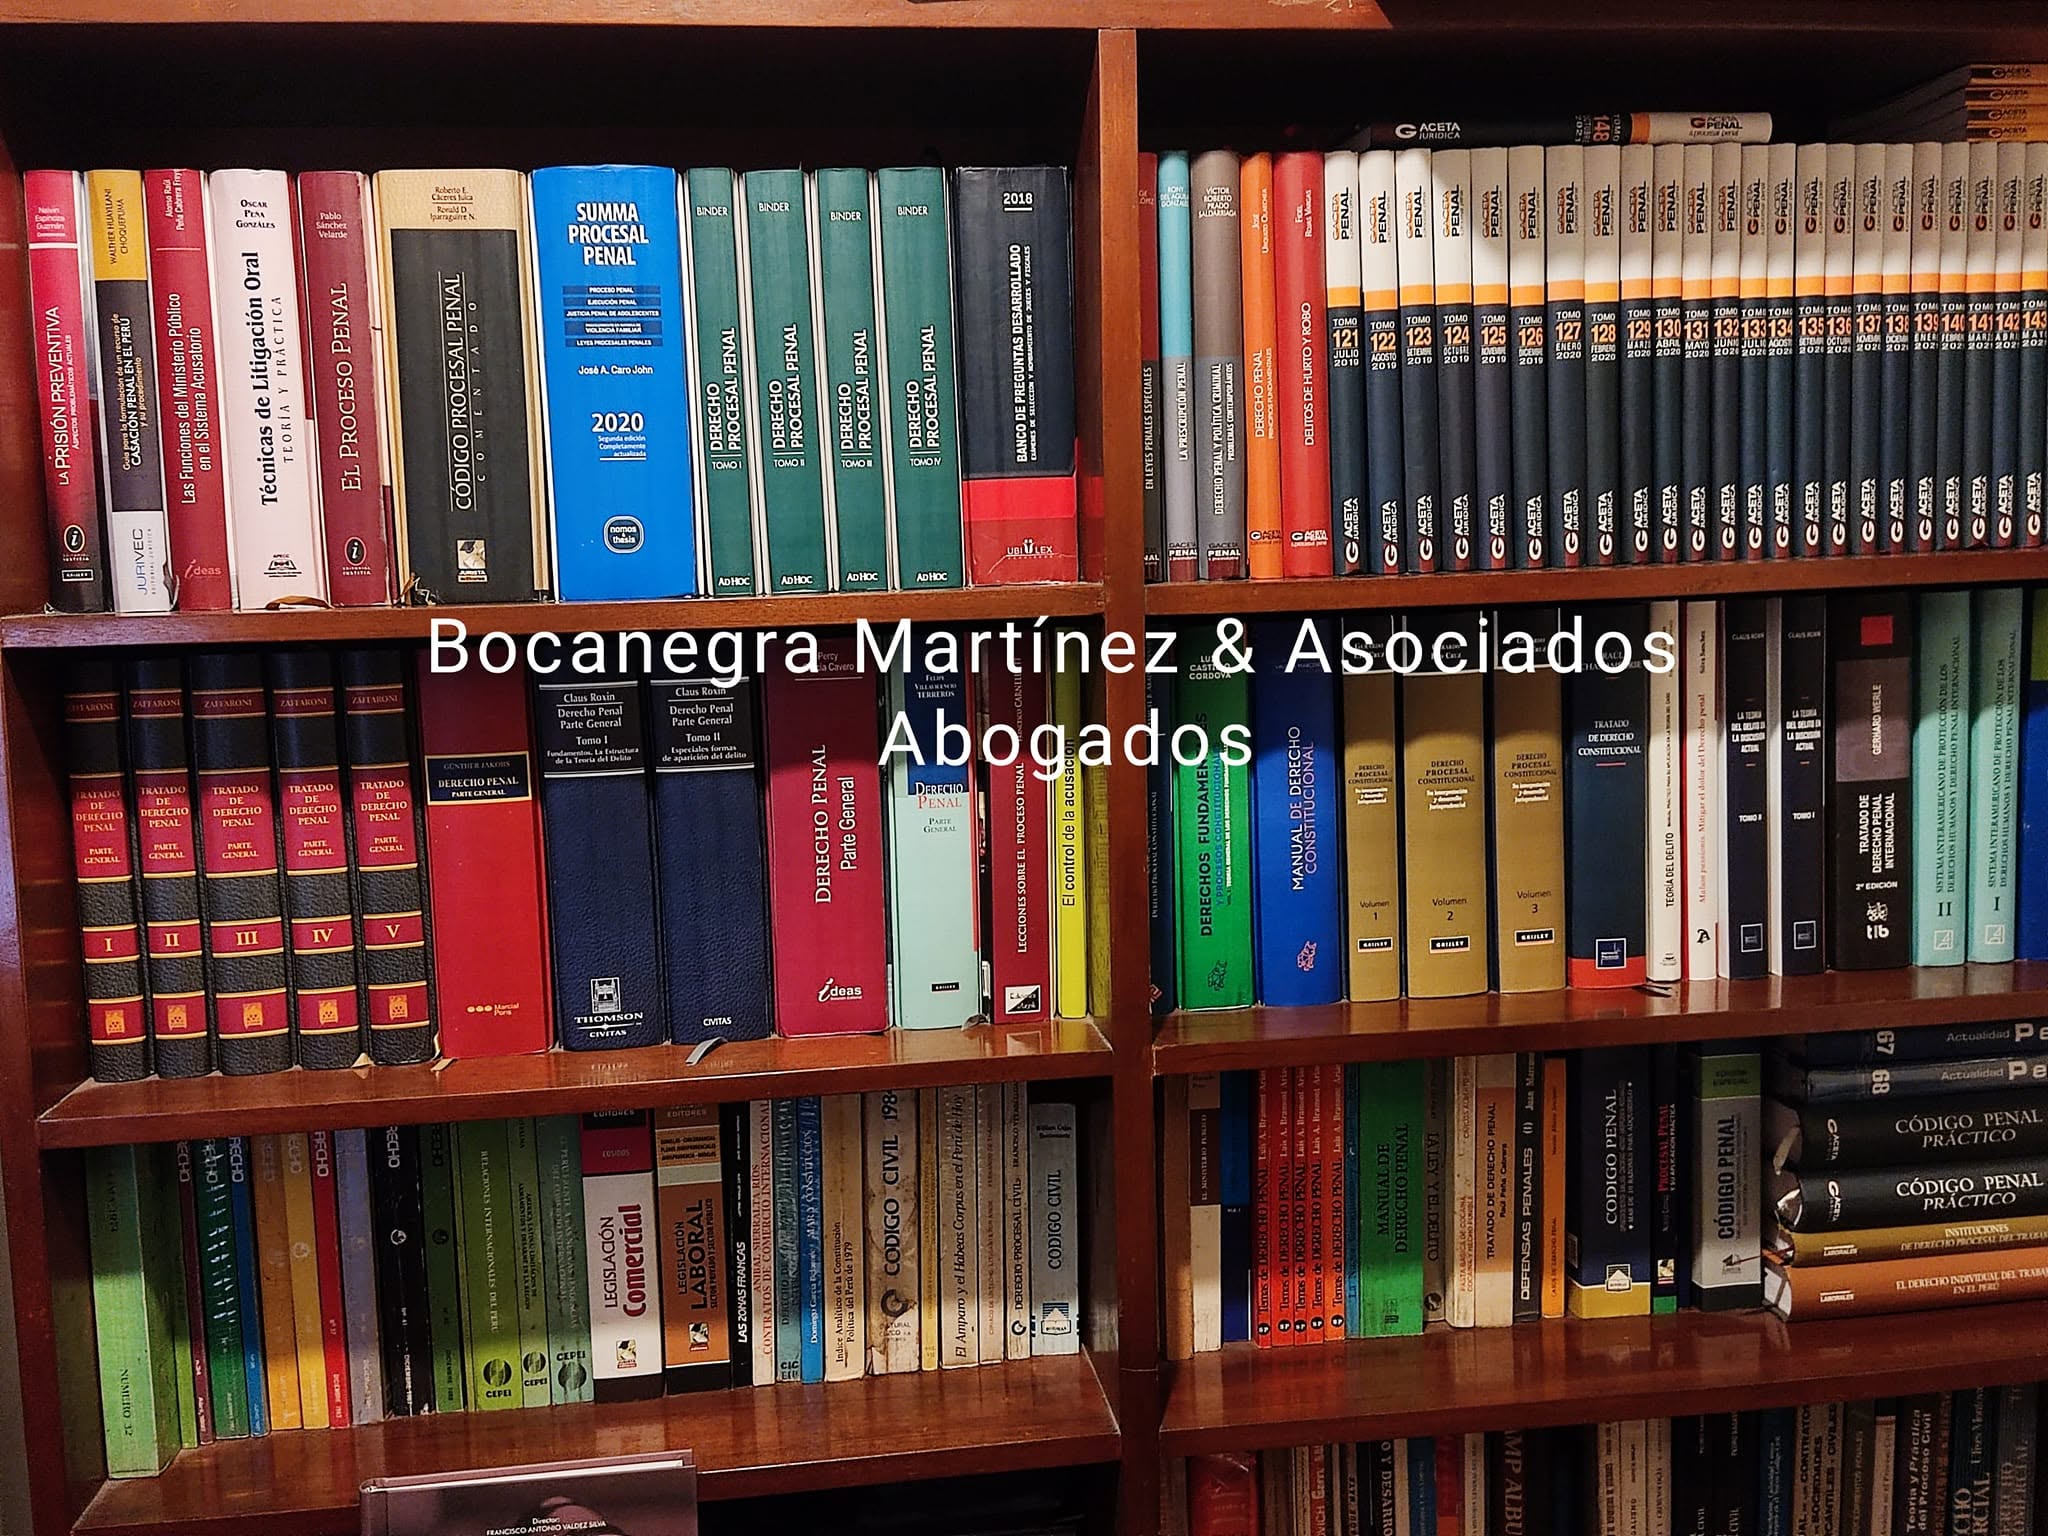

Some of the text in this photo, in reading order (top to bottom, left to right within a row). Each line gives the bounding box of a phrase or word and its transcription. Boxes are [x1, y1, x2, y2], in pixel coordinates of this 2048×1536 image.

[240, 200, 268, 208] OSCAR
[758, 201, 791, 213] BINDER
[1003, 193, 1033, 205] 2018
[320, 212, 342, 221] Pablo
[576, 202, 639, 222] SUMMA
[316, 221, 347, 230] Sánchez
[318, 230, 347, 239] Velarde
[568, 224, 649, 244] PROCESAL
[583, 246, 636, 266] PENAL
[1332, 318, 1357, 326] TOMO
[1556, 321, 1582, 341] 127
[1655, 319, 1681, 338] 130
[271, 296, 287, 376] PRÁCTICA
[1332, 329, 1359, 348] 121
[1406, 327, 1432, 346] 123
[1009, 244, 1028, 463] BANCO DE PREGUNTAS DESARROLLADO
[1333, 349, 1358, 359] JULIO
[1334, 358, 1359, 367] 2019
[240, 253, 277, 505] Técnicas de Litigación Oral
[578, 365, 653, 375] José A. Caro John
[1301, 302, 1314, 446] DELITOS DE HURTO Y ROBO
[46, 306, 70, 486] LA PRISIÓN PREVENTIVA
[330, 282, 362, 491] EL PROCESO PENAL
[444, 274, 472, 509] CÓDIGO PROCESAL PENAL
[468, 302, 486, 481] COMENTADO
[722, 327, 742, 451] PROCESAL PENAL
[168, 294, 195, 504] Las Funciones del Ministerio Público
[186, 327, 211, 470] en el Sistema Acusatorio
[591, 412, 644, 433] 2020
[706, 383, 723, 451] DERECHO
[277, 405, 294, 464] TEORÍA
[610, 525, 637, 533] nomos
[612, 535, 636, 545] thesis
[132, 528, 149, 596] JURIVEC
[564, 691, 615, 703] Claus Roxin
[557, 706, 622, 718] Derecho Penal
[560, 718, 622, 729] Parte General
[1594, 719, 1629, 729] TRATADO
[576, 735, 608, 745] Tomo I
[1588, 732, 1634, 742] DE DERECHO
[1578, 745, 1641, 756] CONSTITUCIONAL
[212, 785, 259, 794] TRATADO
[438, 775, 519, 788] DERECHO PENAL
[916, 782, 963, 796] DERECHO
[213, 806, 262, 816] DERECHO
[229, 797, 244, 805] DE
[917, 796, 962, 809] PENAL
[1288, 726, 1304, 891] MANUAL DE DERECHO
[1303, 741, 1318, 874] CONSTITUCIONAL
[222, 817, 255, 826] PENAL
[811, 744, 831, 904] DERECHO PENAL
[837, 776, 857, 870] Parte General
[1859, 795, 1869, 854] TRATADO DE
[1885, 793, 1895, 869] INTERNACIONAL
[1872, 794, 1882, 873] DERECHO PENAL
[222, 849, 259, 858] GENERAL
[227, 842, 252, 850] PARTE
[1063, 810, 1075, 907] El control de la
[1198, 852, 1212, 937] DERECHOS
[1432, 898, 1467, 906] Volumen
[1447, 912, 1453, 921] 2
[236, 931, 258, 945] III
[575, 1012, 643, 1025] THOMSON
[590, 1030, 626, 1038] CIVITAS
[1877, 1031, 1894, 1055] 67
[1946, 1030, 2010, 1042] Actualidad
[1872, 1069, 1890, 1094] 68
[1896, 1110, 2043, 1134] CÓDIGO PENAL
[1923, 1128, 2016, 1148] PRÁCTICO
[1605, 1089, 1617, 1225] CODIGO PENAL
[1487, 1103, 1495, 1260] TRATADO DE DERECHO PENAL
[1713, 1115, 1735, 1239] CÓDIGO PENAL
[1376, 1144, 1390, 1236] MANUAL DE
[1395, 1124, 1409, 1253] DERECHO PENAL
[882, 1134, 900, 1276] CODIGO CIVIL
[1521, 1147, 1533, 1300] DEFENSAS PENALES
[1945, 1224, 2009, 1237] INSTITUCIONES
[598, 1216, 618, 1308] LEGISLACIÓN
[618, 1204, 646, 1317] Comercial
[673, 1222, 687, 1295] LEGISLACIÓN
[686, 1200, 708, 1309] LABORAL
[736, 1242, 747, 1343] LAS ZONAS FRANCAS
[121, 1369, 131, 1418] NUMERO
[487, 1527, 526, 1535] FRANCISCO
